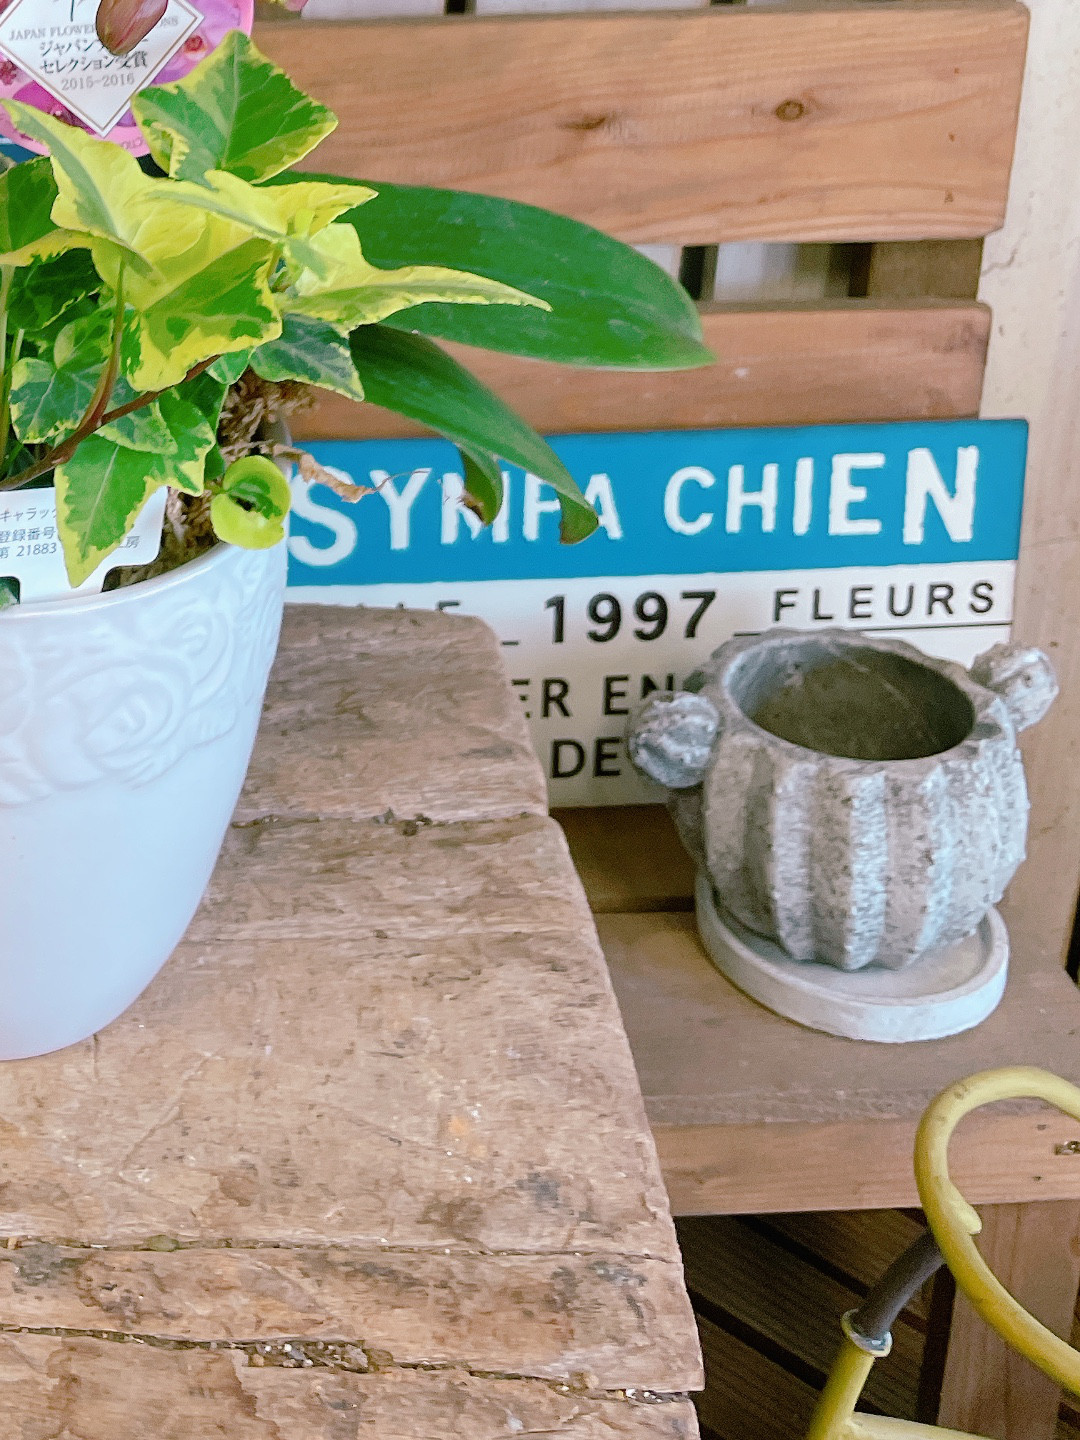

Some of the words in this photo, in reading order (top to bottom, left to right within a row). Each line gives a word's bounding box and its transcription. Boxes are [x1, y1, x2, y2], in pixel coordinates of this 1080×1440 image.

[50, 23, 96, 37] FLOWE
[61, 72, 136, 92] 2015-2016
[663, 444, 980, 546] CHIEN
[545, 590, 718, 644] 1997
[773, 581, 995, 622] FLEURS
